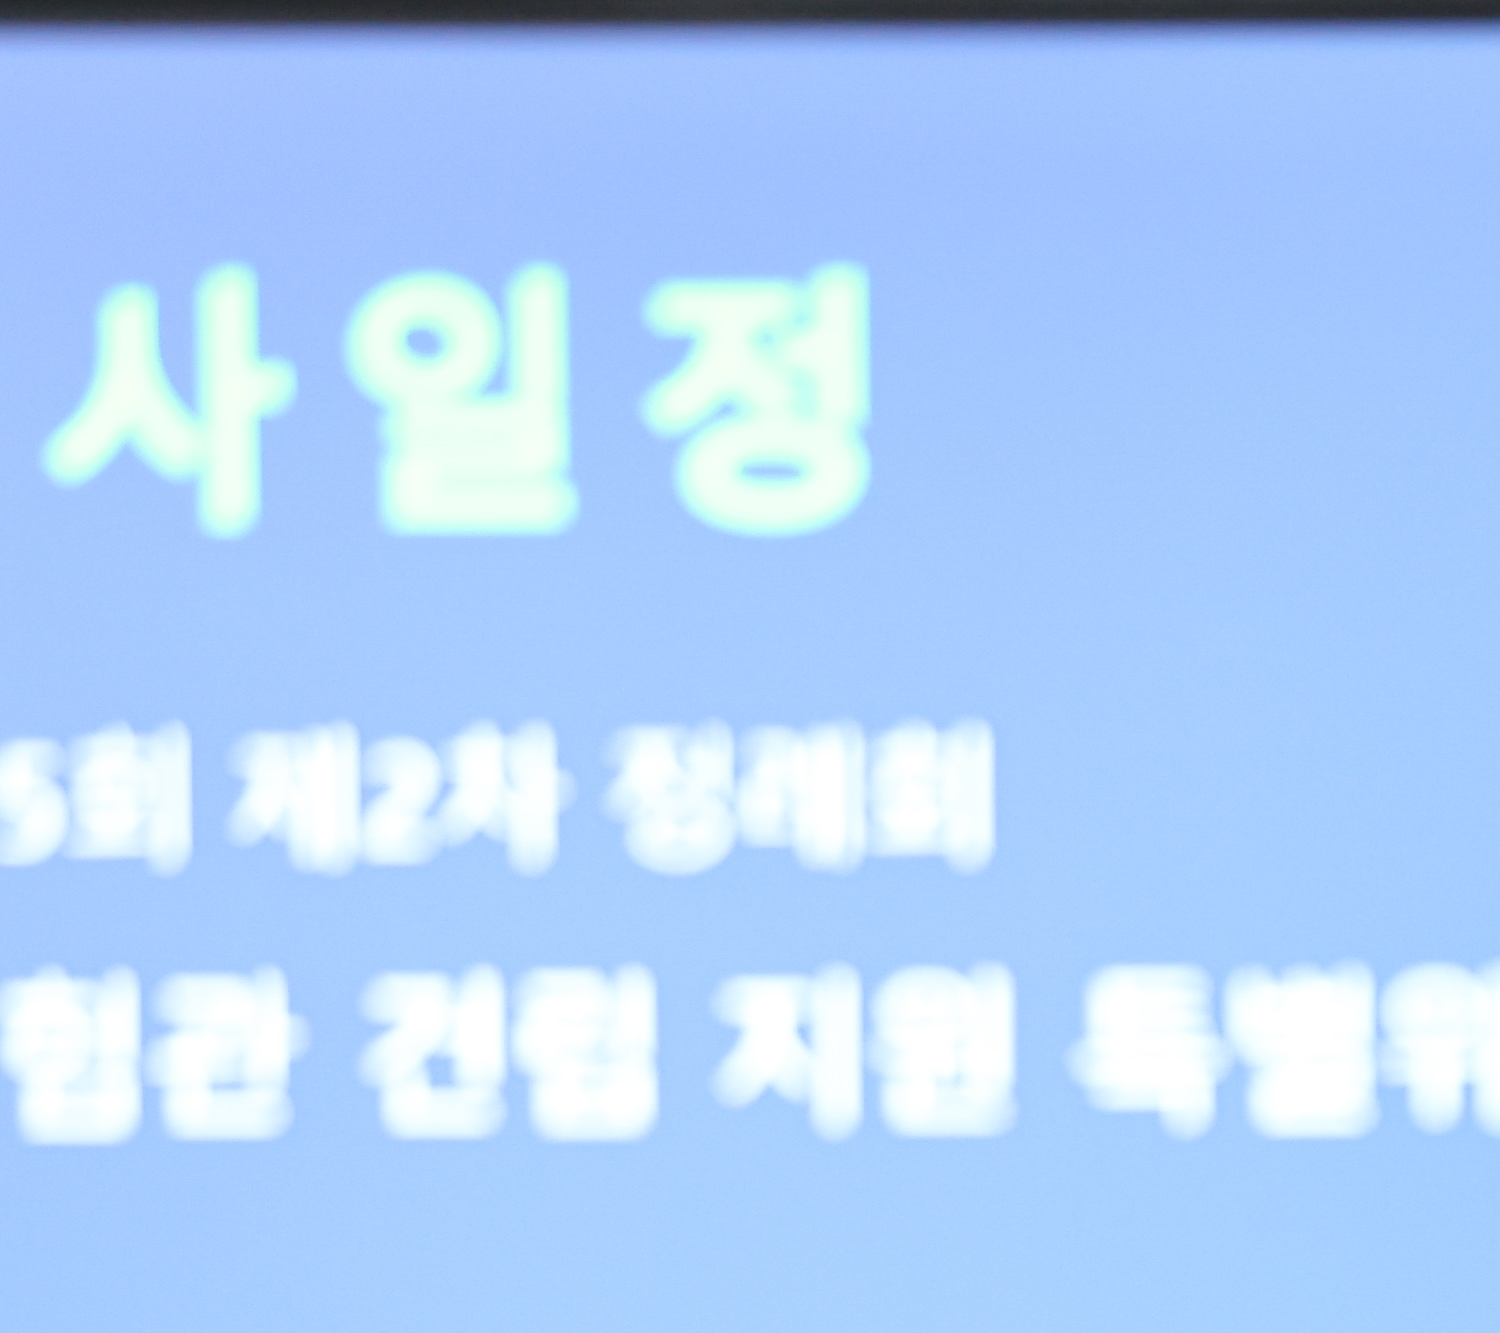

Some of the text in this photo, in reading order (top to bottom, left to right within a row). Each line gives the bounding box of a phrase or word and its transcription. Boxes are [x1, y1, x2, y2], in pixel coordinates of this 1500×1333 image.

[228, 720, 572, 874] 제2차
[605, 720, 998, 876] 정례회
[359, 961, 662, 1144] 건립
[714, 962, 1019, 1142] 지원
